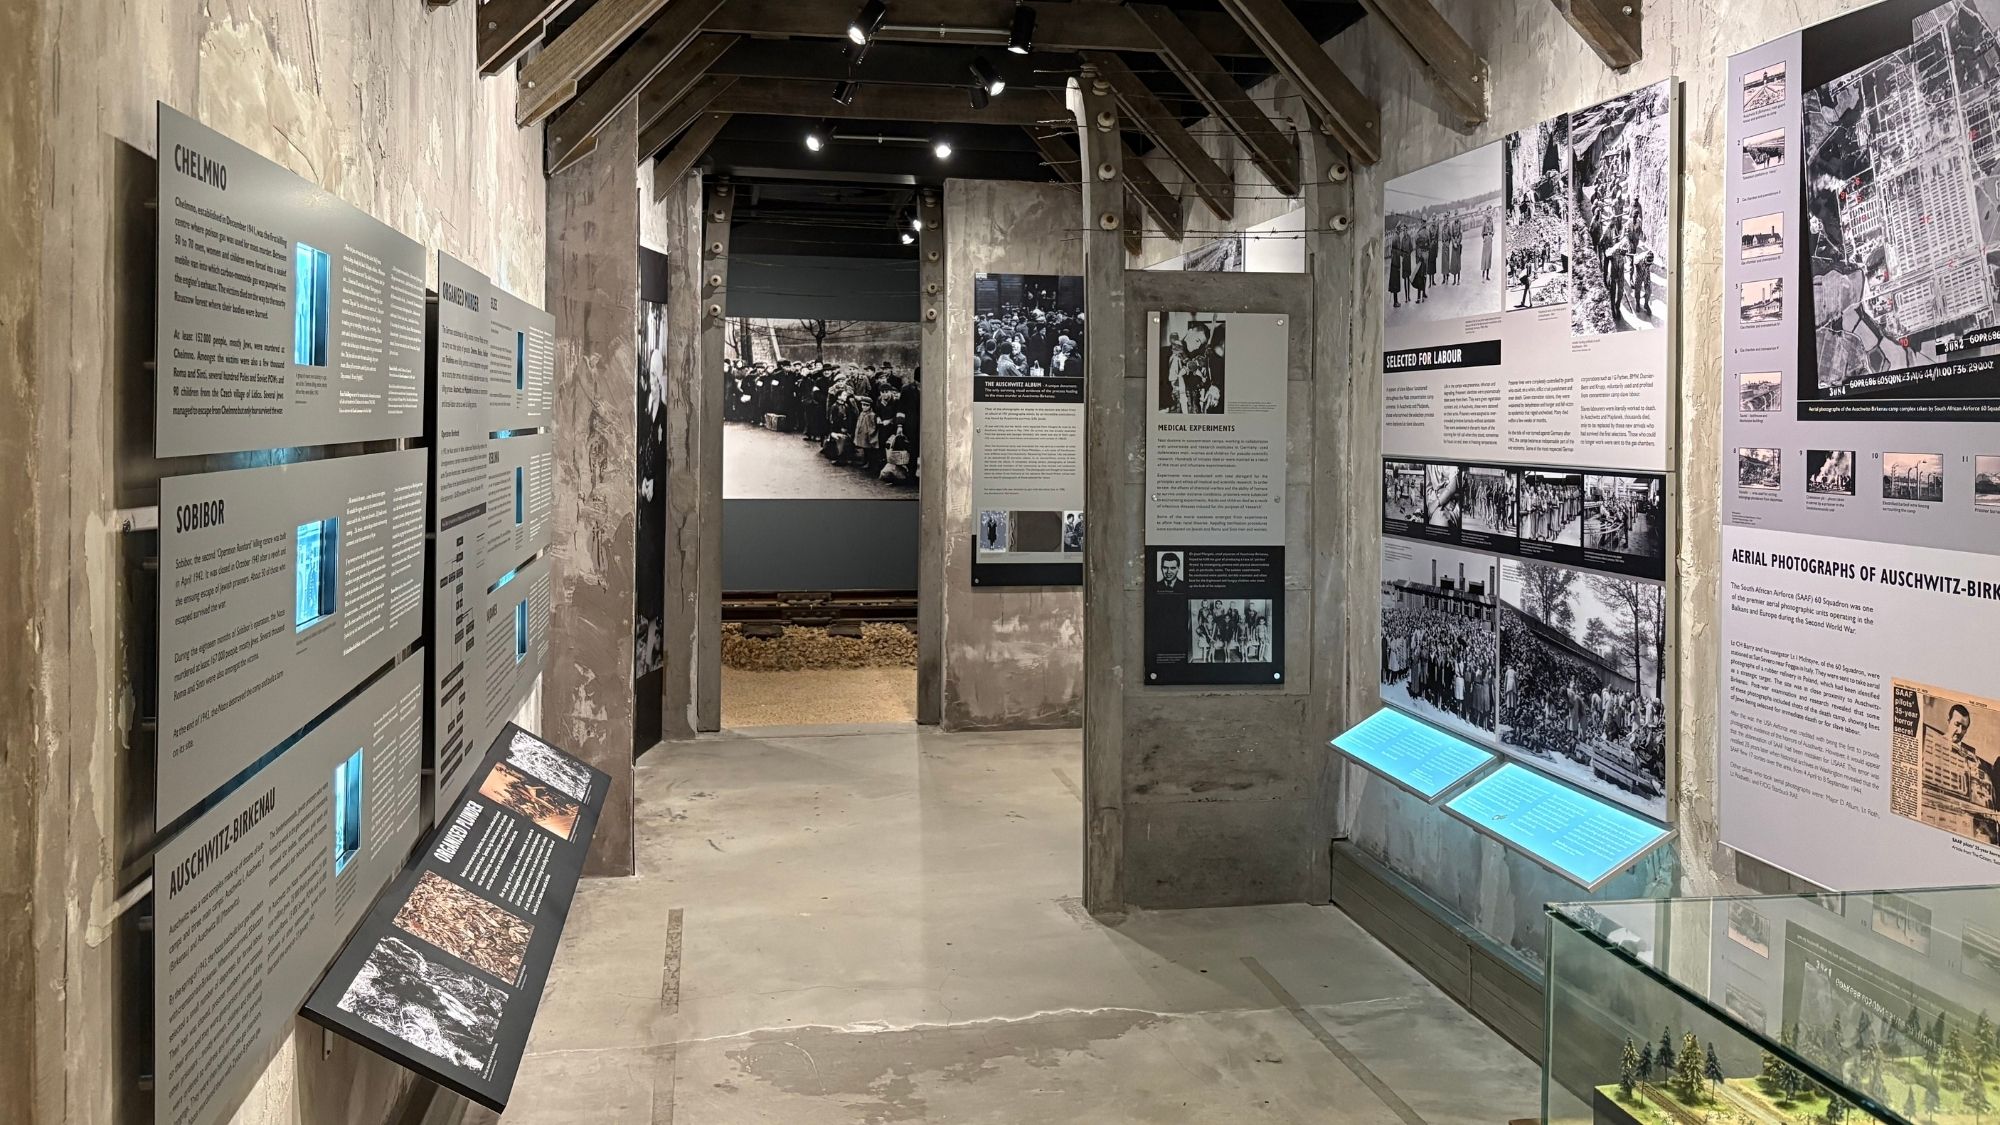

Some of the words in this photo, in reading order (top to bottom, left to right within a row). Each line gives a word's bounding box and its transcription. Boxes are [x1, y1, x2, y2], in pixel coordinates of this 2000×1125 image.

[175, 144, 226, 191] CHELMNO
[1386, 354, 1416, 368] SELECTED
[1419, 352, 1432, 365] FOR
[1434, 349, 1462, 364] LABOUR
[177, 500, 224, 533] SOBIBOR
[1732, 549, 1767, 567] AERIAL
[1771, 554, 1855, 579] PHOTOGRAPHS
[1860, 566, 1876, 582] OF
[1881, 568, 2000, 600] AUSCHWITZ-BIRK
[1730, 581, 1739, 589] The
[1740, 583, 1754, 592] South
[1755, 586, 1772, 594] African
[1773, 589, 1793, 599] Airforce
[1795, 592, 1812, 603] (SAAF)
[1822, 597, 1848, 608] Squadron
[1731, 603, 1748, 613] Balkans
[1759, 608, 1777, 619] Europe
[1778, 613, 1794, 624] during
[1804, 617, 1824, 627] Second
[1825, 622, 1842, 631] World
[1780, 602, 1814, 614] photographic
[1829, 612, 1856, 623] operating
[1857, 689, 1879, 699] identified
[1896, 689, 1913, 698] SAAF
[1847, 716, 1867, 728] showing
[1868, 722, 1879, 730] lines
[1895, 707, 1918, 718] 35-year
[1895, 716, 1913, 726] horror
[170, 787, 275, 900] AUSCHWITZ-BIRKENAU
[434, 825, 467, 863] ORGANISED
[456, 800, 484, 830] PLUNDER
